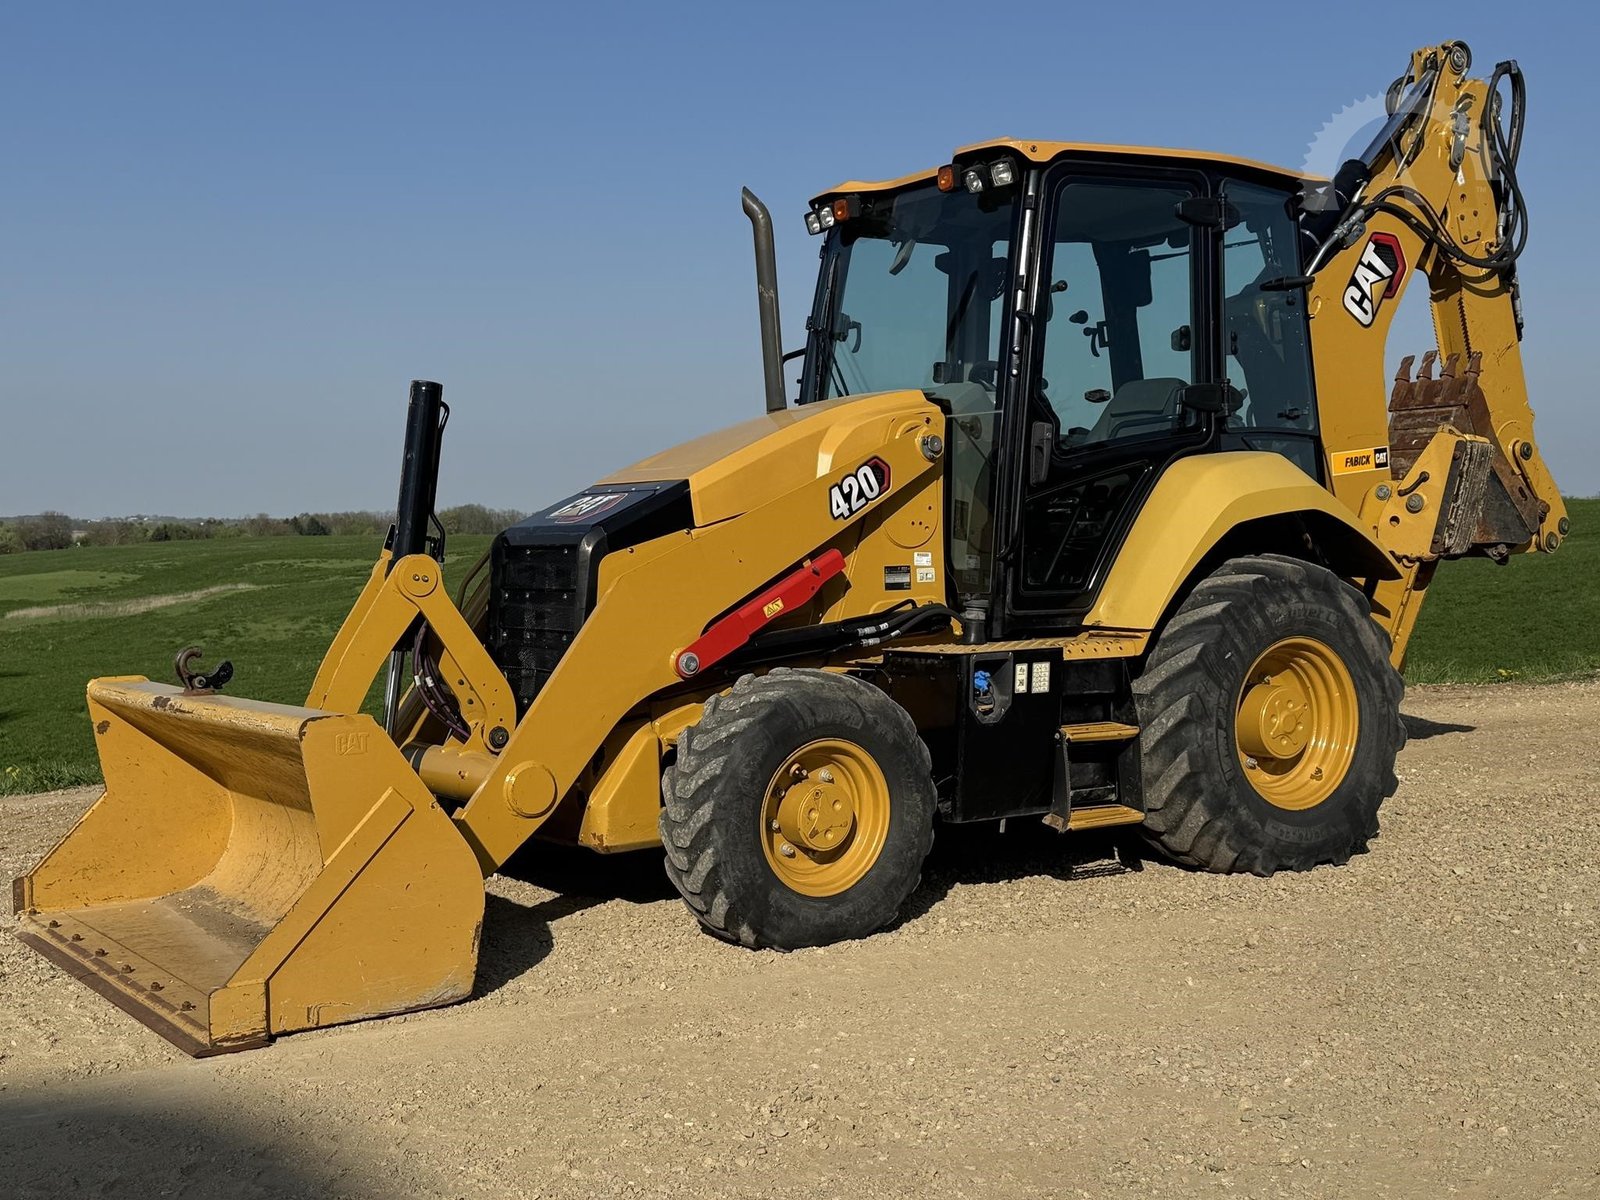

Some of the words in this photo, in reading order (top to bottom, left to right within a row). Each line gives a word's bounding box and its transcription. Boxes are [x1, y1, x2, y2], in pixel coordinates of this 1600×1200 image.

[1342, 240, 1394, 326] CAT
[1344, 454, 1372, 468] FABICK
[1375, 452, 1387, 464] CAT
[830, 464, 880, 518] 420
[548, 494, 621, 517] CAT
[335, 731, 370, 757] CAT
